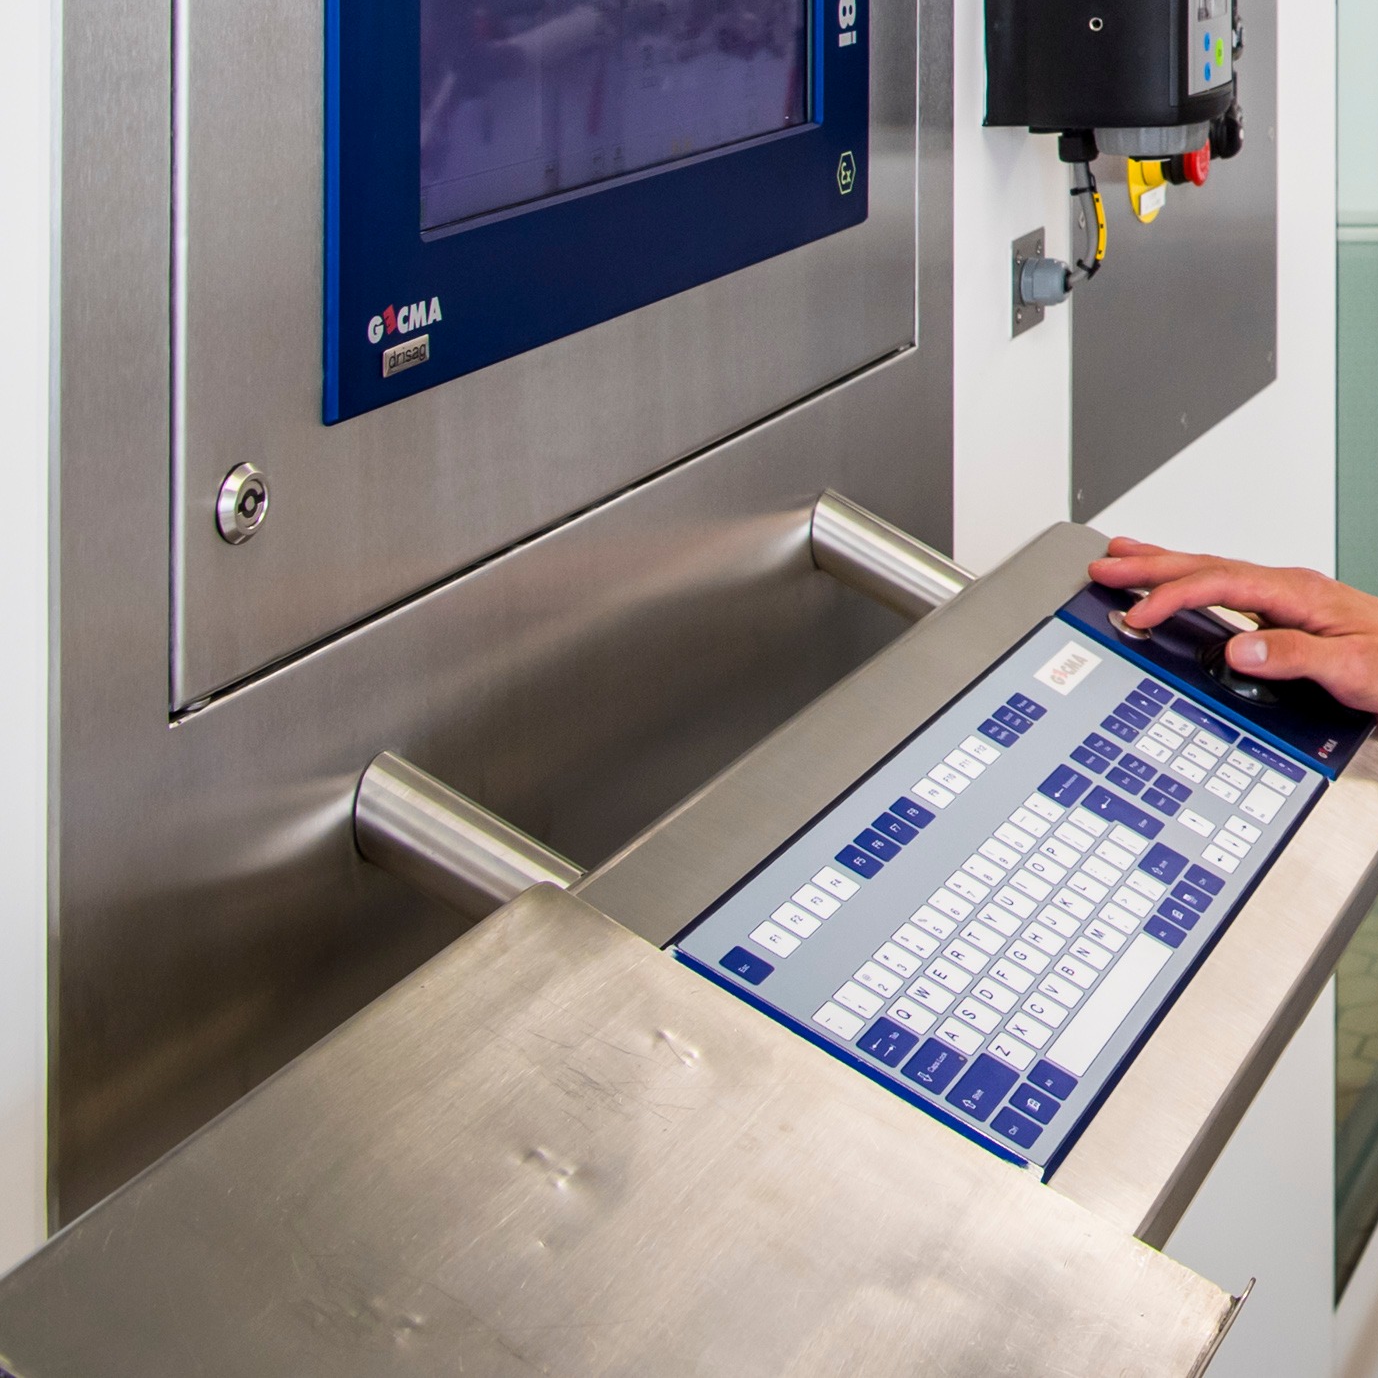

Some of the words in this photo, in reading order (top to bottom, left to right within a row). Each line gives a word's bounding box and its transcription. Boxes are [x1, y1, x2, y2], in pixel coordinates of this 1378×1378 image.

[972, 743, 988, 755] F12
[957, 757, 972, 769] F11
[941, 771, 957, 783] F10
[926, 787, 940, 798] F9
[905, 806, 920, 817] F8
[888, 822, 903, 833] F7
[870, 838, 885, 850] F6
[852, 855, 867, 867] F5
[829, 877, 844, 888] F4
[809, 895, 824, 906] F3
[789, 913, 804, 925] F2
[768, 933, 783, 944] F1
